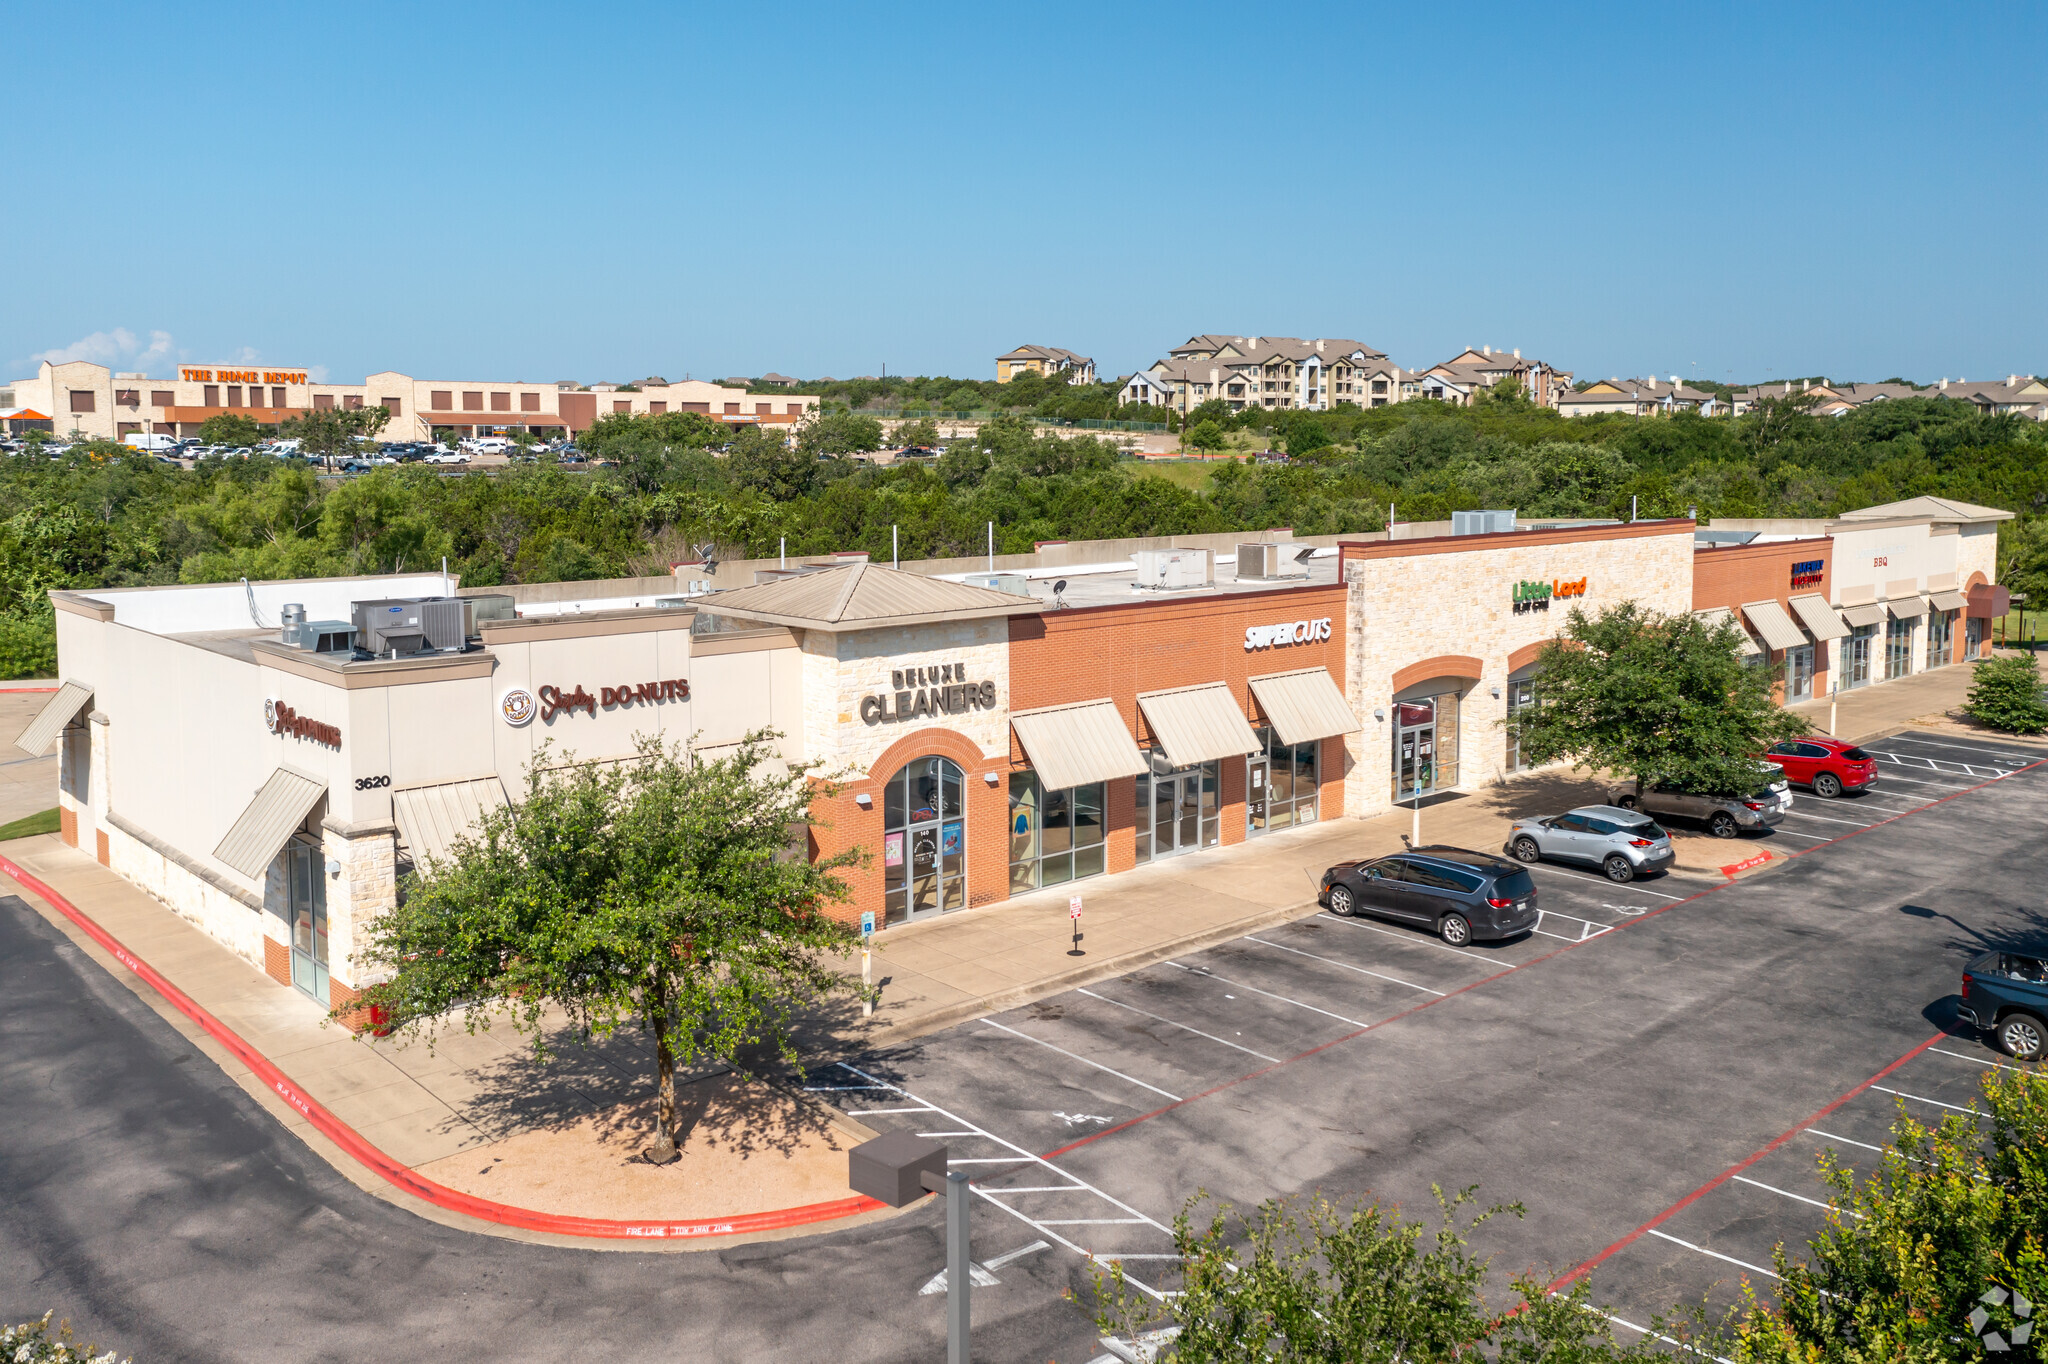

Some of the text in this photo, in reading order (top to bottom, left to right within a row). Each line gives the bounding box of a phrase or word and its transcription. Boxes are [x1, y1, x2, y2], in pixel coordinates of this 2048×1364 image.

[182, 369, 307, 384] THE HOME DEPOT
[1792, 560, 1824, 574] LAKEWAY
[1873, 556, 1887, 567] BBQ
[1513, 576, 1587, 600] Little Land
[1244, 617, 1331, 649] SUPERCUTS
[892, 663, 965, 688] DELUXE
[538, 679, 689, 721] Shipley DO-NUTS
[860, 680, 997, 725] CLEANERS
[355, 775, 391, 791] 3620
[626, 1223, 734, 1237] FIRE LANE TOW AWAY ZONE
